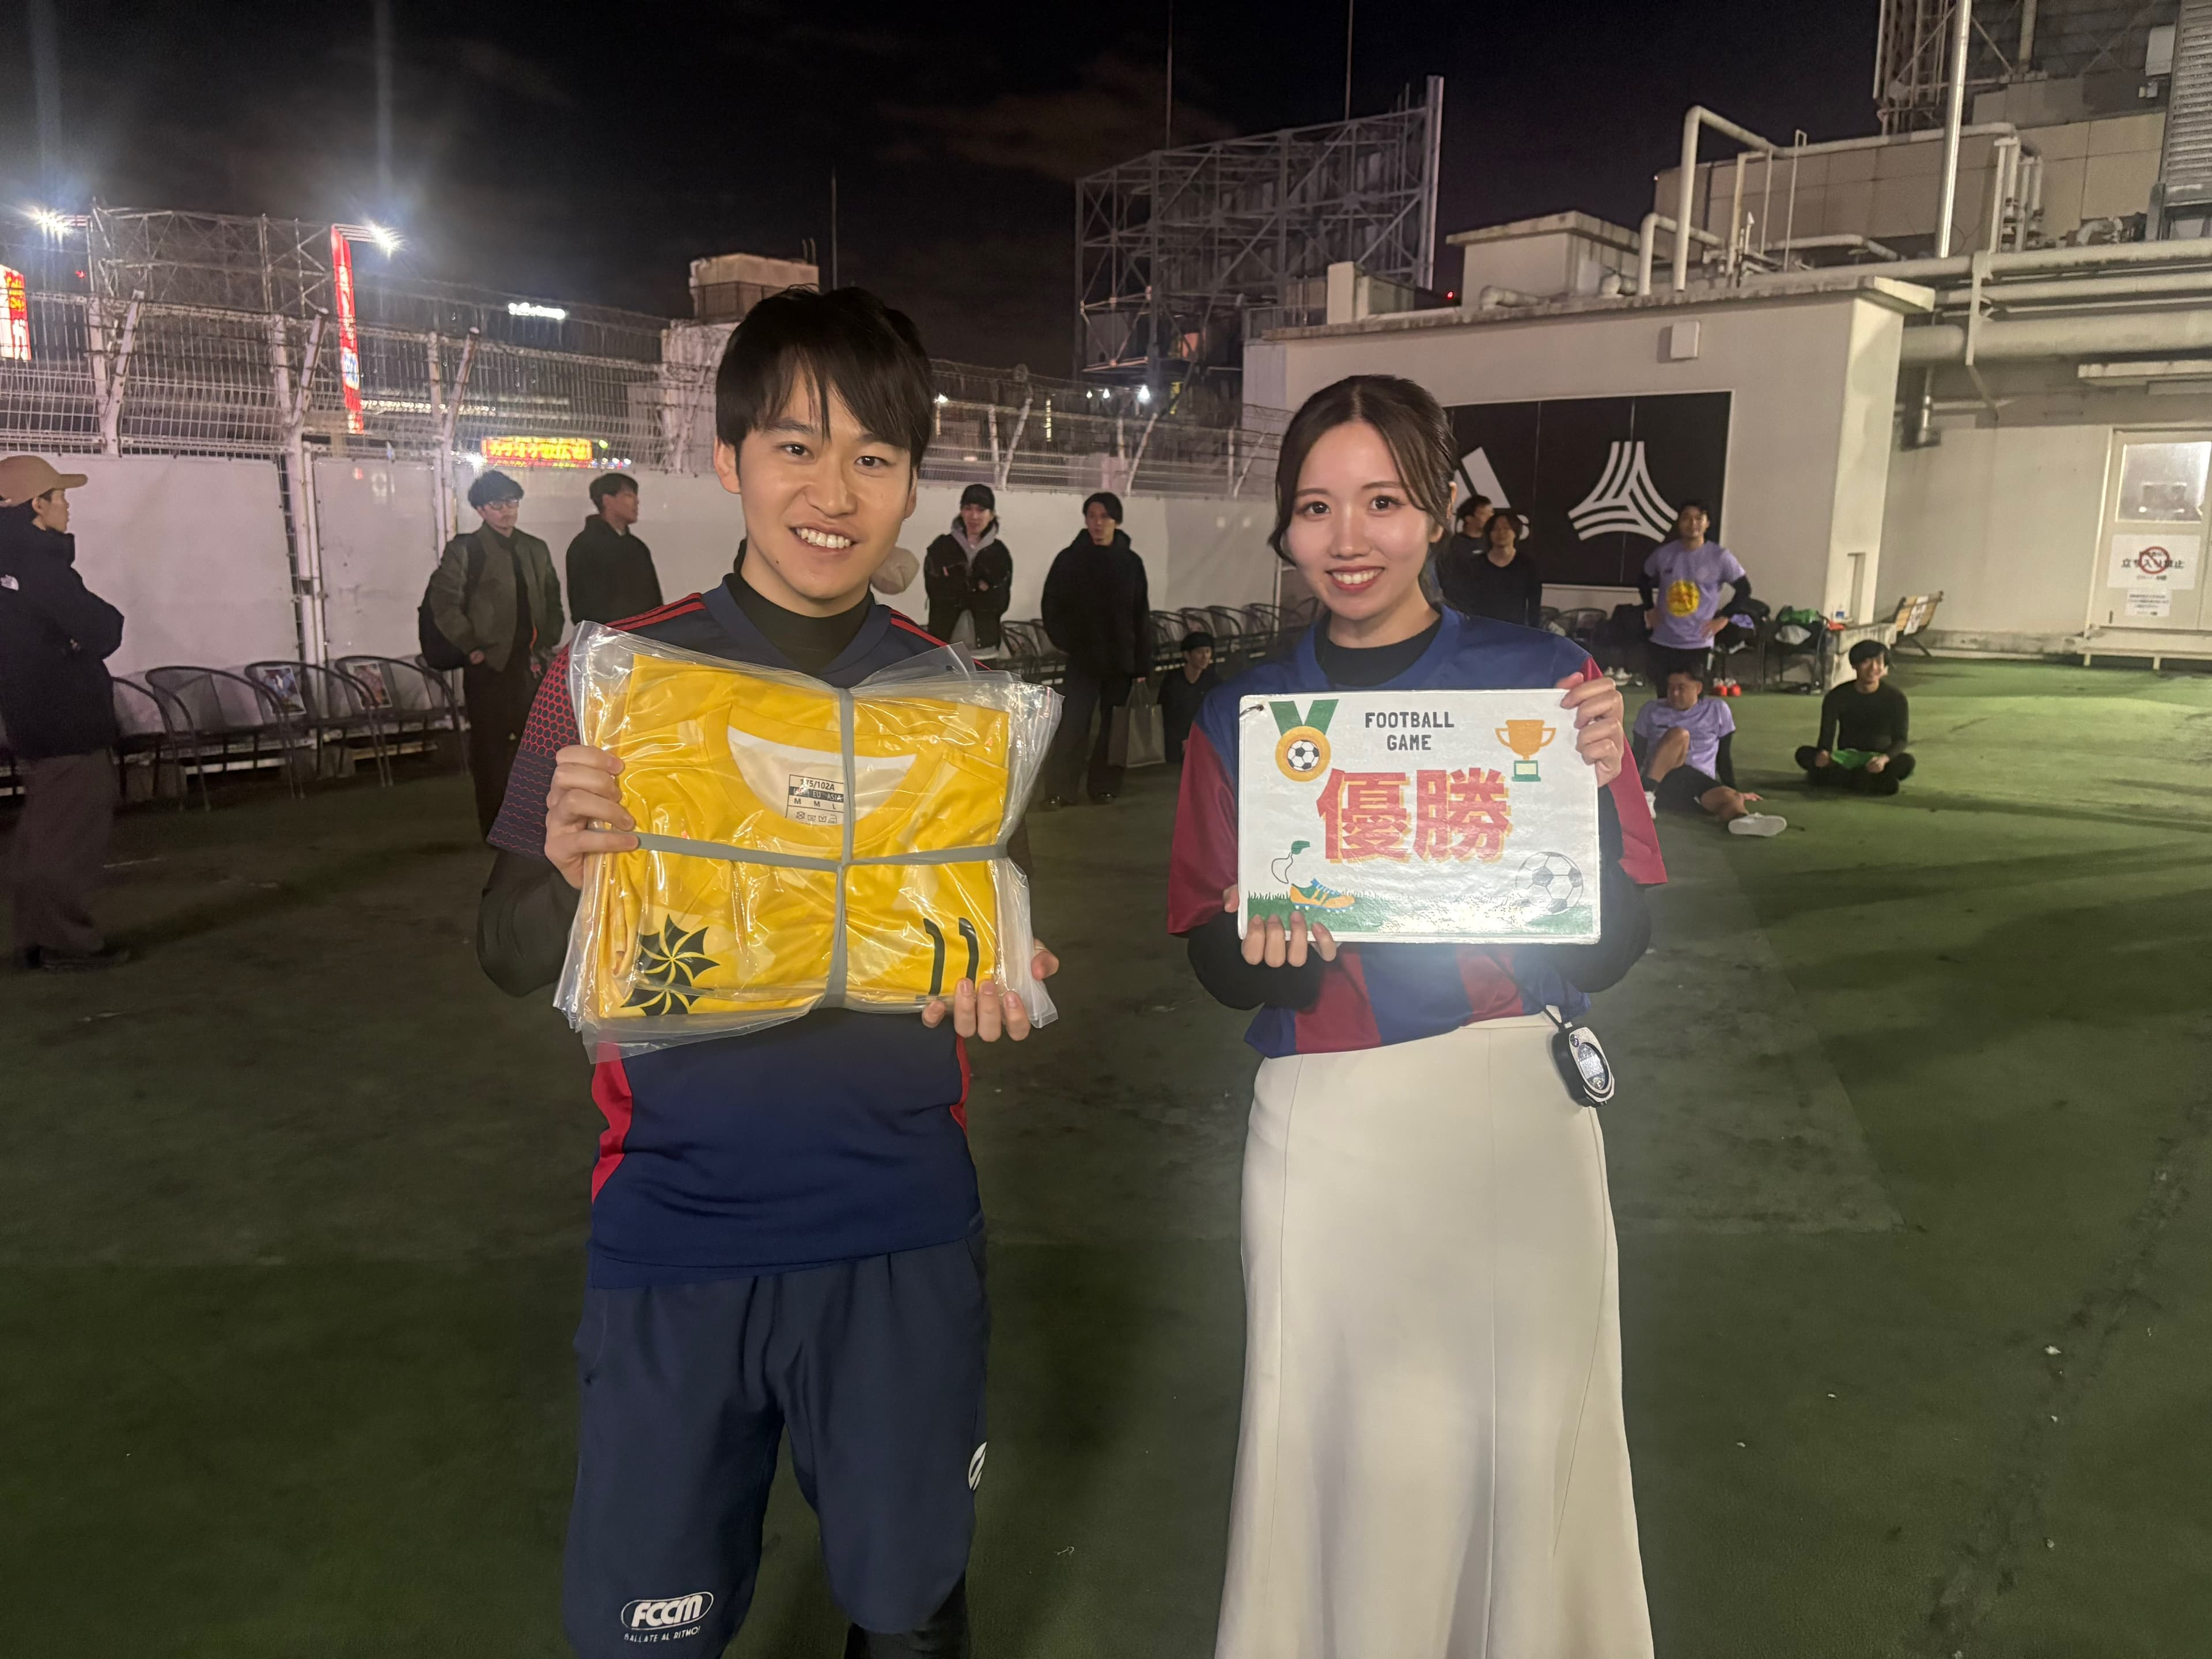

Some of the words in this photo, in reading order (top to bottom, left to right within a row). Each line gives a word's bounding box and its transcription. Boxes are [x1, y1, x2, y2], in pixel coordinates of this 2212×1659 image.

[1365, 711, 1455, 728] FOOTBALL
[1387, 734, 1431, 751] GAME
[827, 793, 842, 801] ASIA
[1316, 767, 1513, 863] 優勝
[923, 917, 979, 995] 11
[631, 1594, 703, 1627] FCCM
[624, 1633, 658, 1642] BALLATE
[661, 1632, 670, 1641] AL
[673, 1626, 700, 1639] RITMO!
